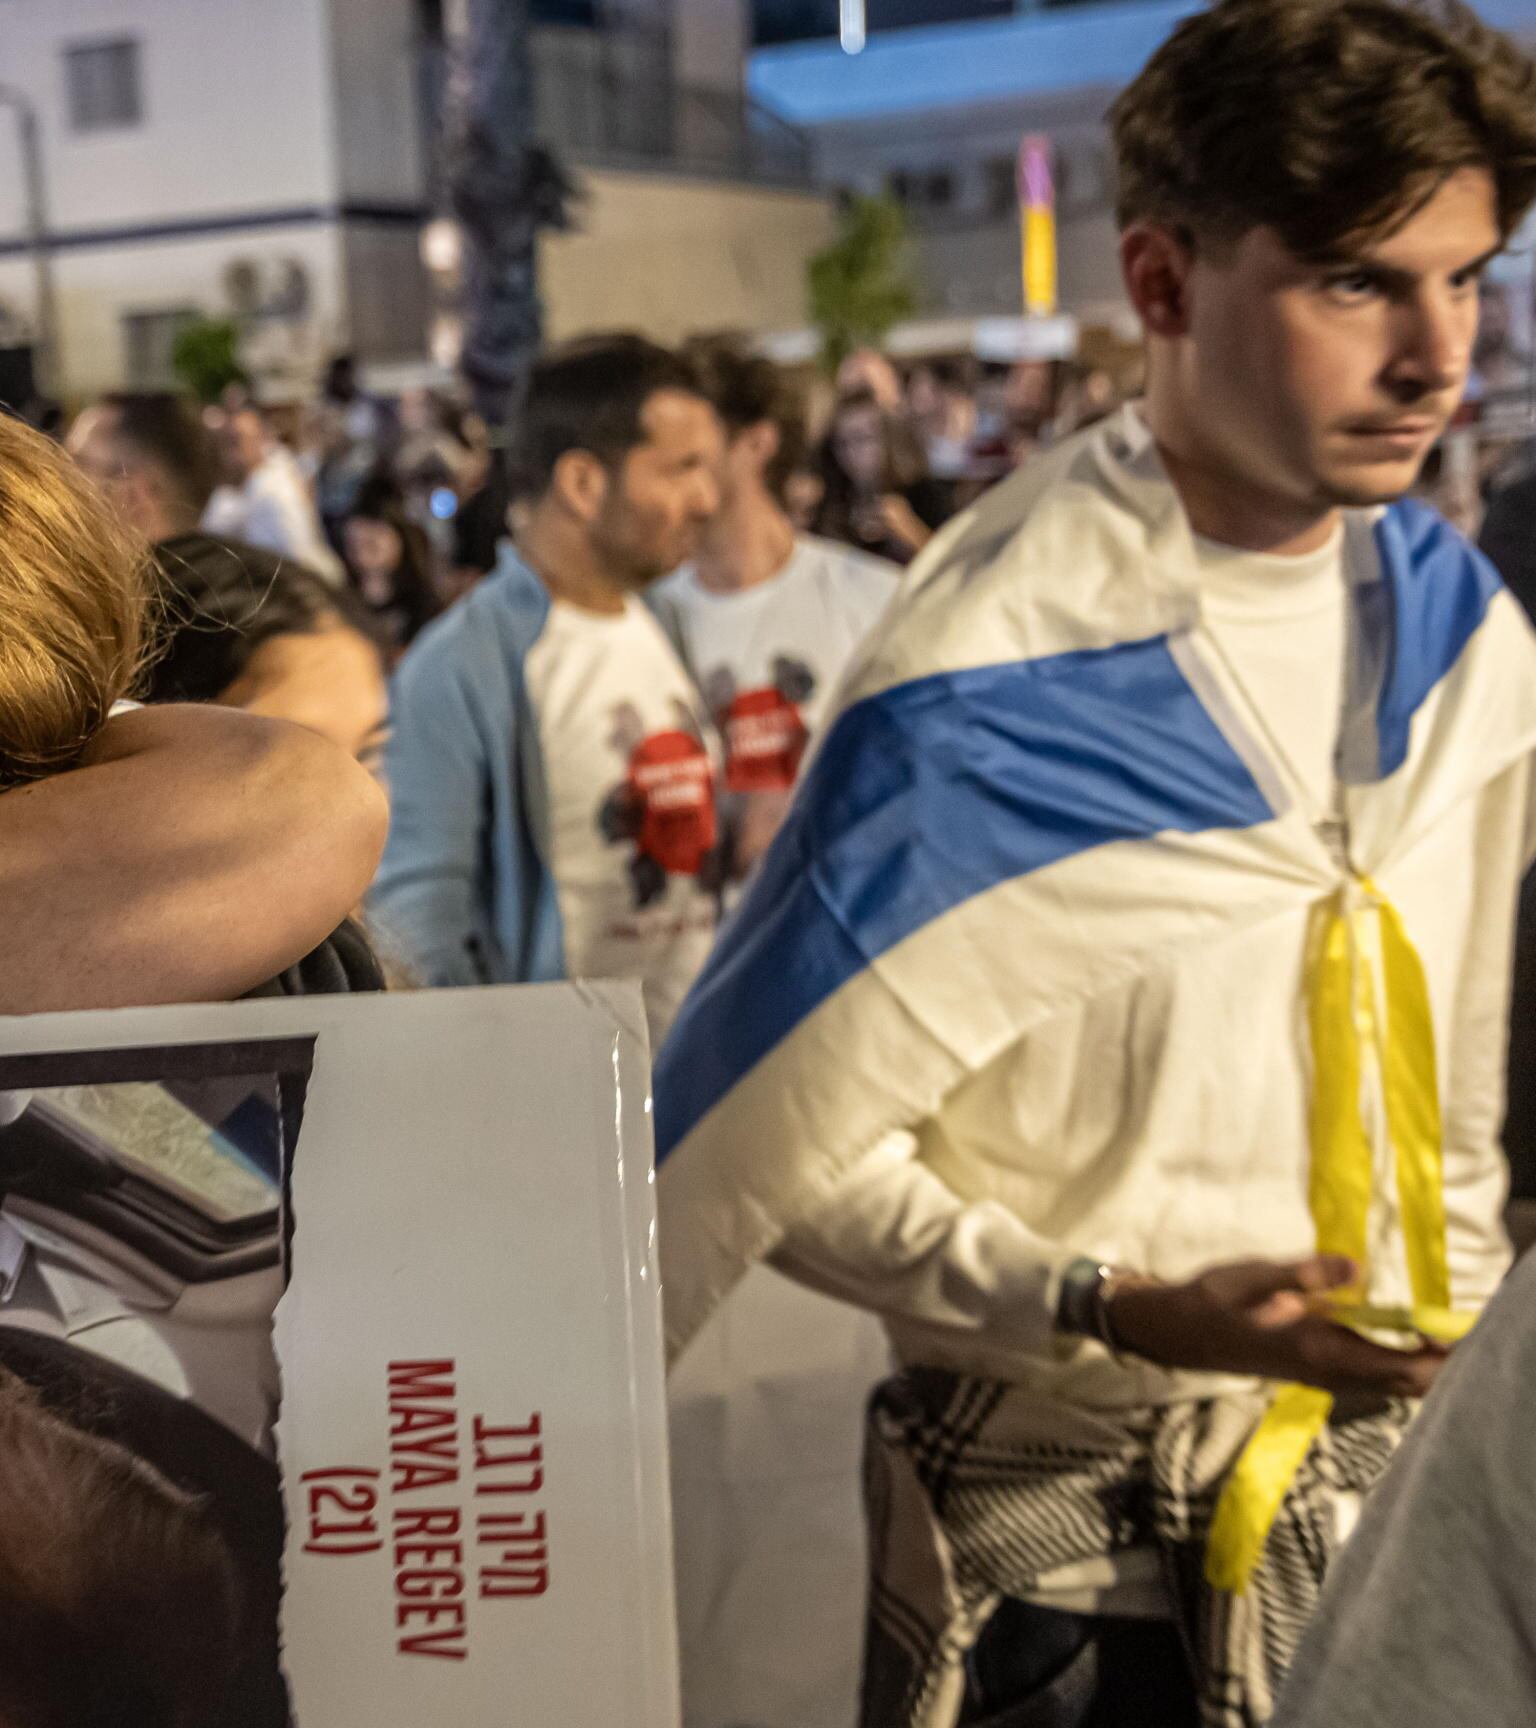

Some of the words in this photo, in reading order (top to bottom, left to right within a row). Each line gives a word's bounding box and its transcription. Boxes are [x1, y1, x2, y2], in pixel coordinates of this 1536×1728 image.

[387, 1358, 461, 1495] MAYA
[472, 1411, 545, 1498] רגב
[300, 1465, 384, 1556] (21)
[477, 1509, 550, 1599] מיה
[392, 1506, 469, 1662] REGEV
